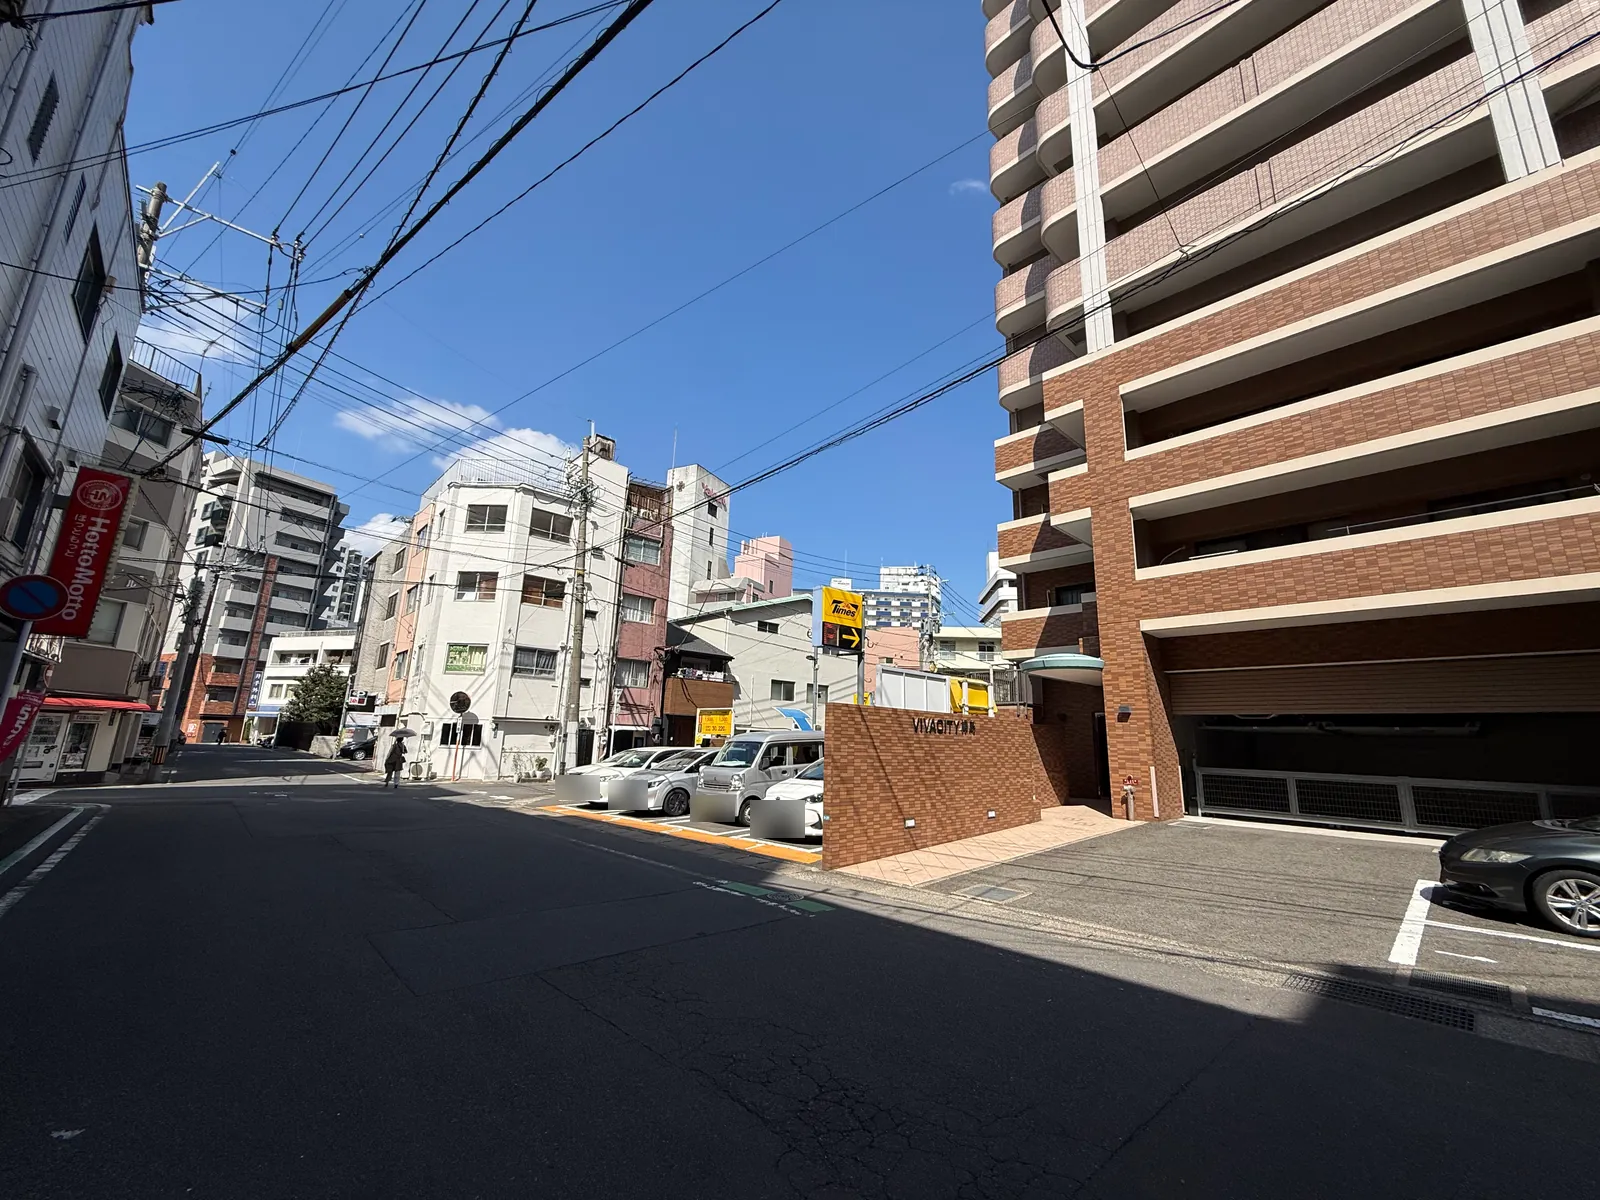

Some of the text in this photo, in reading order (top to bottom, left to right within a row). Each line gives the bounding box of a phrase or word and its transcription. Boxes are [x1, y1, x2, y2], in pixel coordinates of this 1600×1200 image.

[64, 513, 88, 558] ほっともっと
[832, 599, 859, 618] Times
